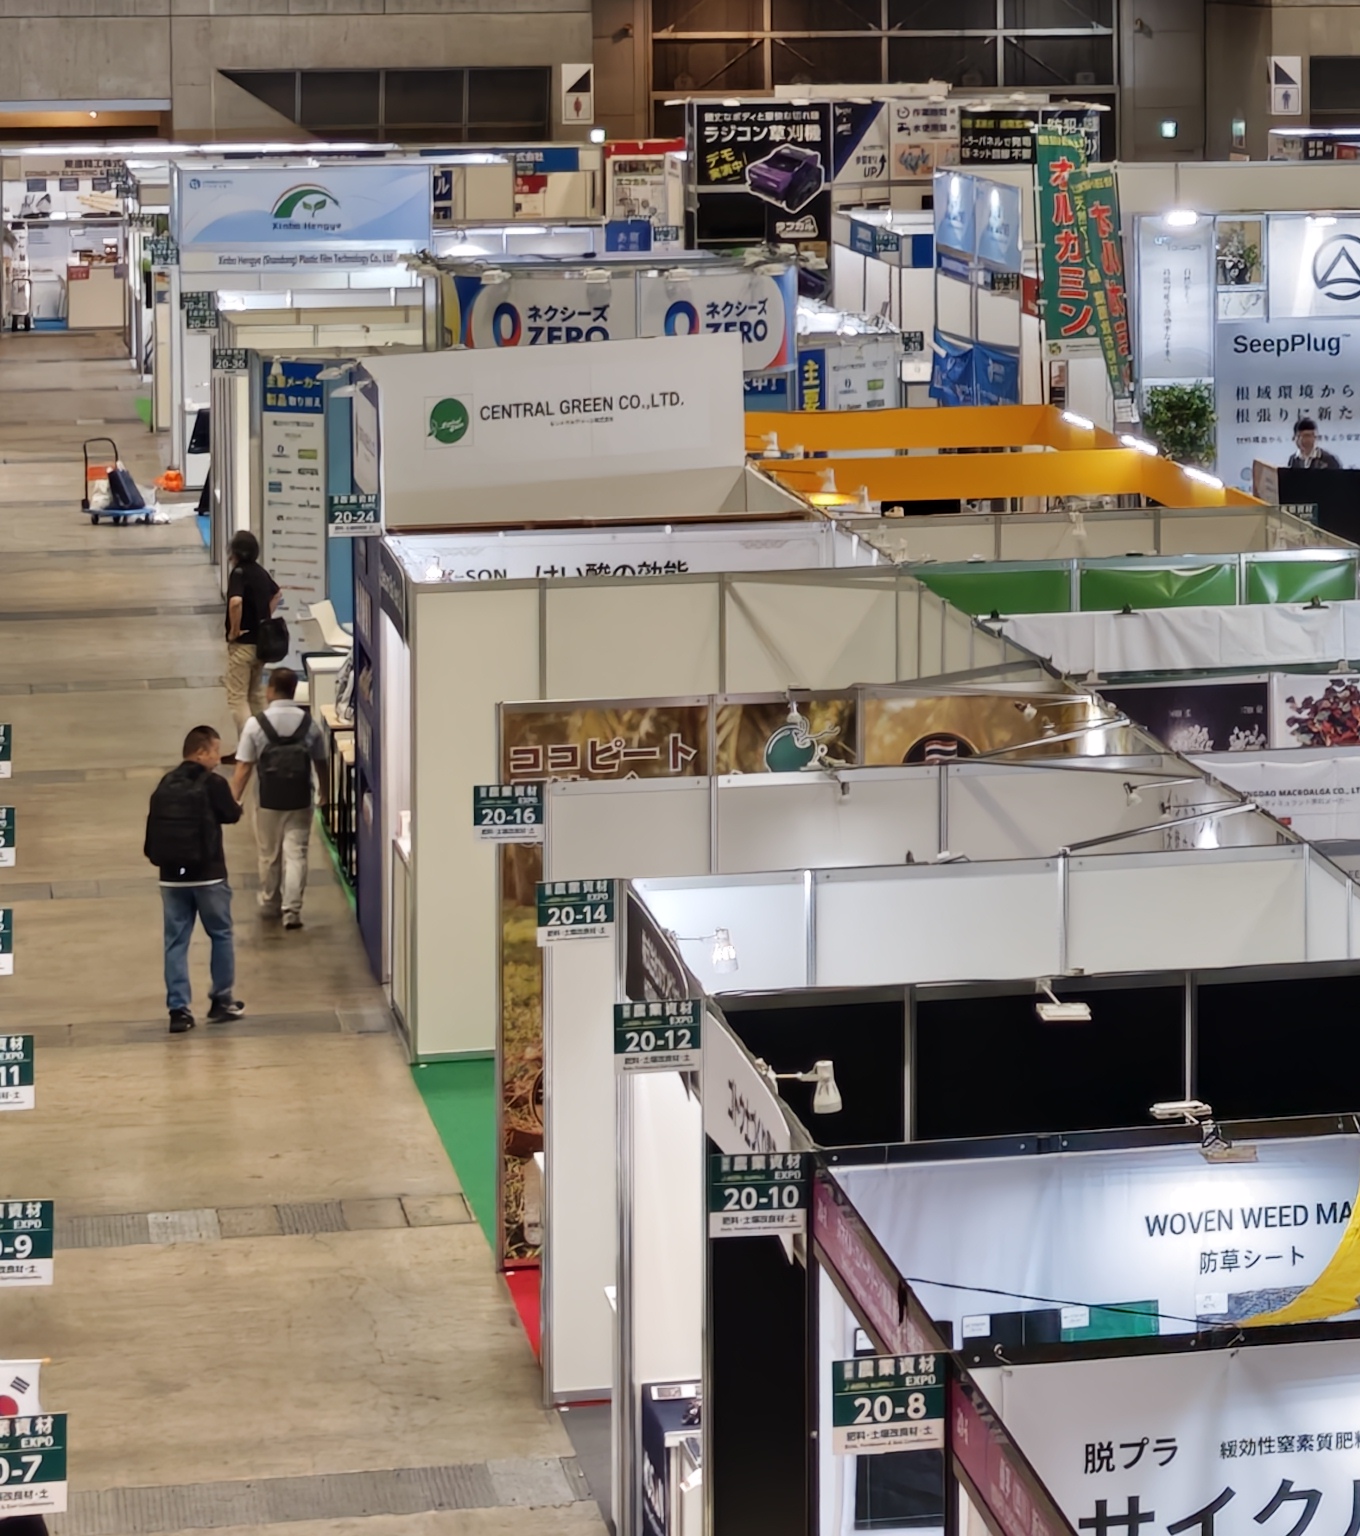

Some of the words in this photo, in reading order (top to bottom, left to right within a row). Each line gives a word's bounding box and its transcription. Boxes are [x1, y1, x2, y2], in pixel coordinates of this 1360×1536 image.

[704, 124, 822, 143] ラジコン草刈機
[864, 166, 878, 178] UP
[1049, 157, 1093, 337] オルカミン
[528, 304, 610, 323] ネクシーズ
[705, 298, 769, 320] ネクシーズ
[480, 400, 555, 421] CENTRAL
[559, 396, 614, 416] GREEN
[618, 392, 685, 412] CO.,LTD.
[334, 511, 375, 524] 20-24
[508, 733, 697, 773] ココピート
[482, 807, 536, 825] 20-16
[587, 893, 609, 901] EXPO
[547, 904, 607, 926] 20-14
[669, 1015, 694, 1026] EXPO
[625, 1028, 692, 1053] 20-12
[774, 1169, 801, 1181] EXPO
[723, 1184, 799, 1211] 20-10
[14, 1219, 43, 1229] EXPO
[1145, 1210, 1232, 1238] WOVEN
[1240, 1205, 1309, 1231] WEED
[1200, 1245, 1306, 1276] 防草シート
[905, 1374, 937, 1387] EXPO
[852, 1392, 927, 1424] 20-8
[21, 1435, 54, 1449] EXPO
[1084, 1437, 1178, 1474] 脱プラ
